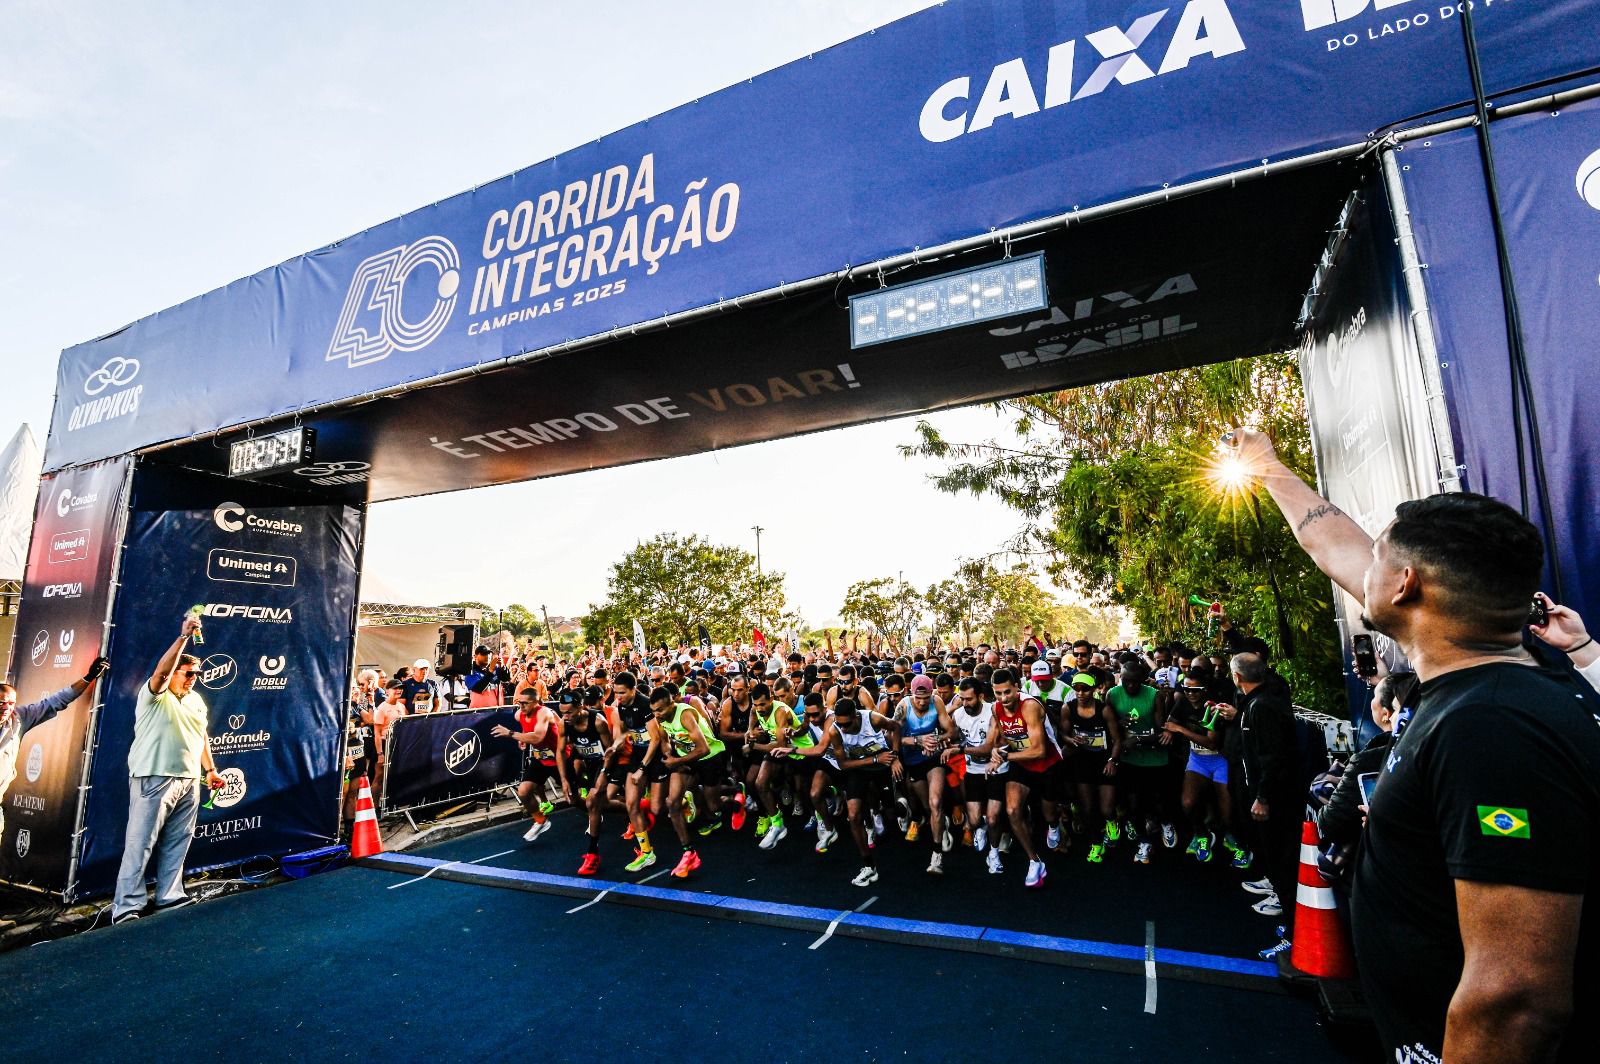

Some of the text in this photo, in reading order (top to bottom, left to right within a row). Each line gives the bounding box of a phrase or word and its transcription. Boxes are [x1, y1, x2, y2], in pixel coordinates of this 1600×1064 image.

[1326, 33, 1358, 51] DO
[1368, 13, 1430, 40] LADO
[918, 0, 1246, 143] CAIXA
[482, 153, 655, 261] CORRIDA
[468, 176, 741, 316] INTEGRAÇÃO
[467, 278, 627, 336] CAMPINAS 2025
[1000, 314, 1198, 369] BRASIL
[1037, 313, 1151, 344] GOVERNO DO
[68, 384, 143, 432] OLYMPIKUS
[429, 363, 861, 460] É TEMPO DE VOAR!
[70, 492, 98, 507] Covabra
[246, 514, 303, 533] Covabra
[54, 537, 78, 551] Unimed
[218, 556, 272, 572] Unimed
[211, 604, 293, 620] OFICINA
[203, 660, 234, 683] EPTV
[208, 729, 271, 745] eofórmula
[449, 734, 477, 769] EPTV
[192, 815, 262, 839] GUATEMI
